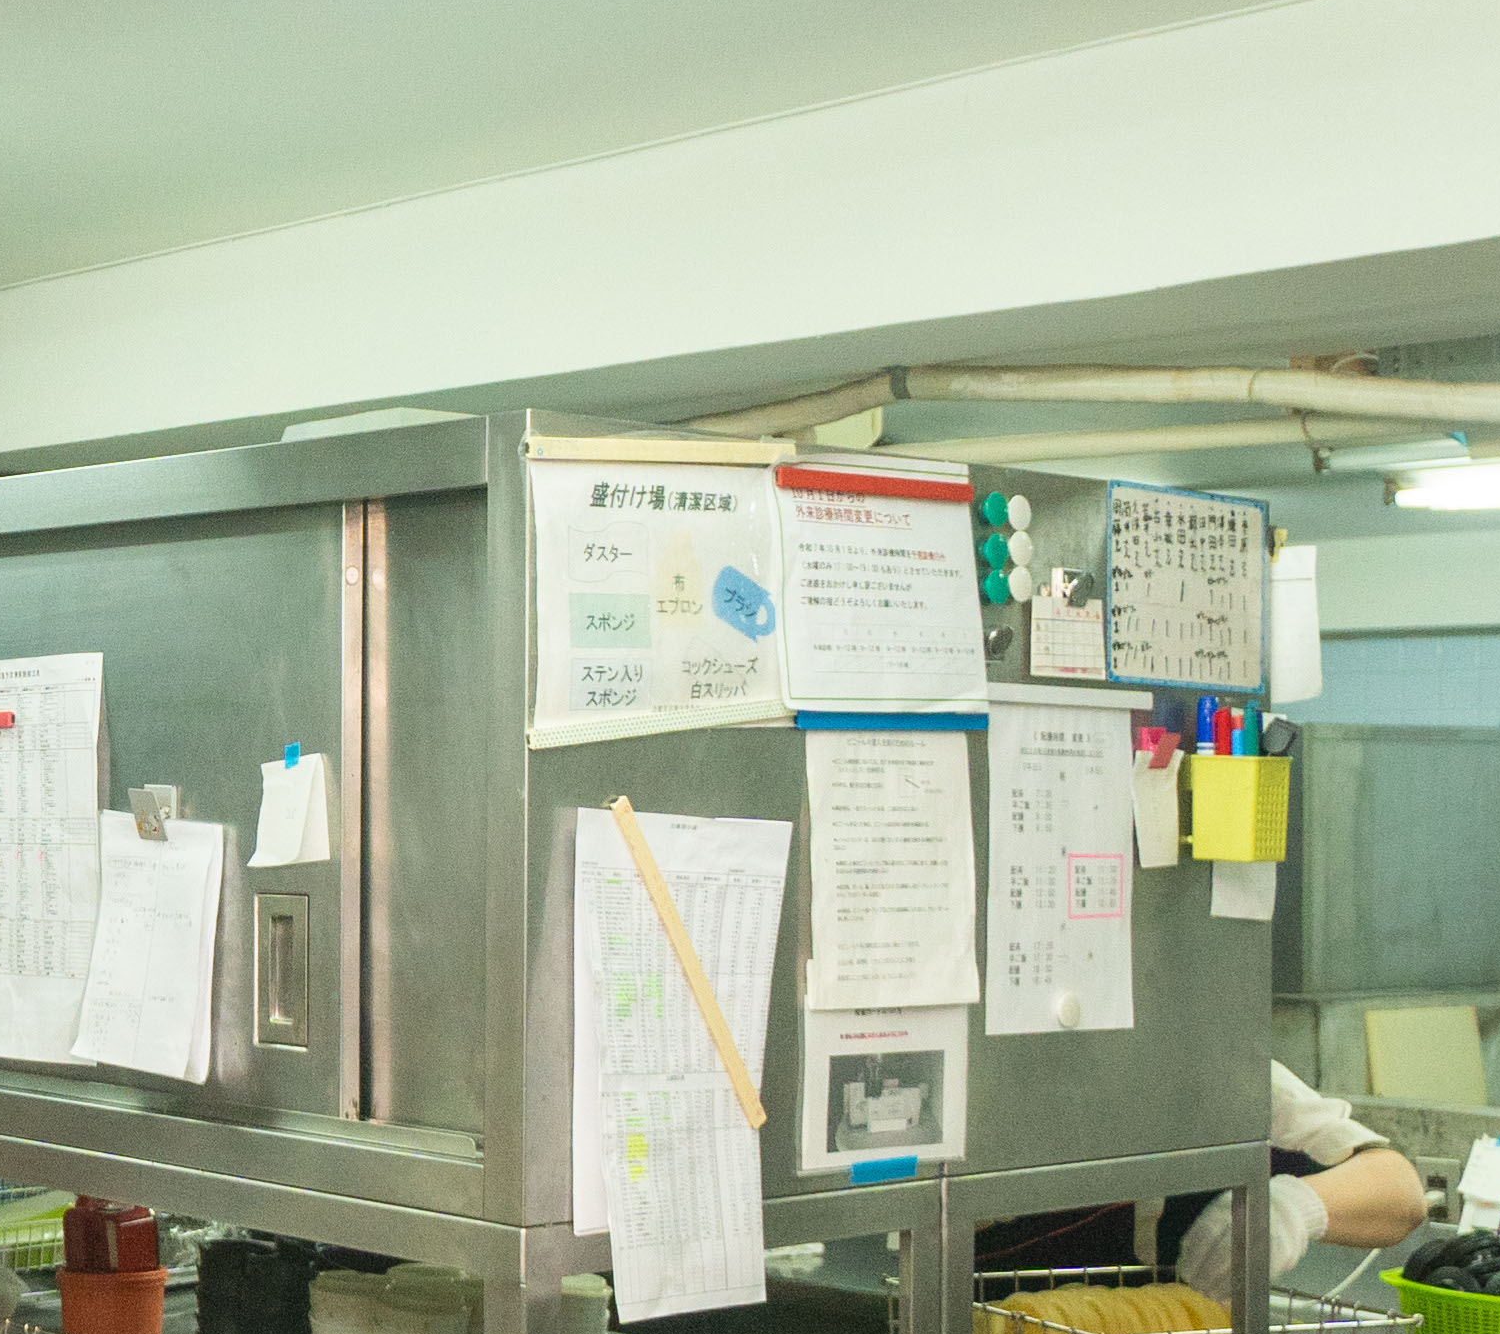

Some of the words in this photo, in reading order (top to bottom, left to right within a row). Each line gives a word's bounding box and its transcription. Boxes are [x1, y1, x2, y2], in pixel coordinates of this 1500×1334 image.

[583, 542, 633, 563] ダスター
[656, 599, 703, 616] エプロン
[586, 613, 636, 632] スポンジ
[581, 665, 643, 684] ステン入り
[681, 656, 759, 675] コックシューズ
[586, 689, 637, 708] スポンジ
